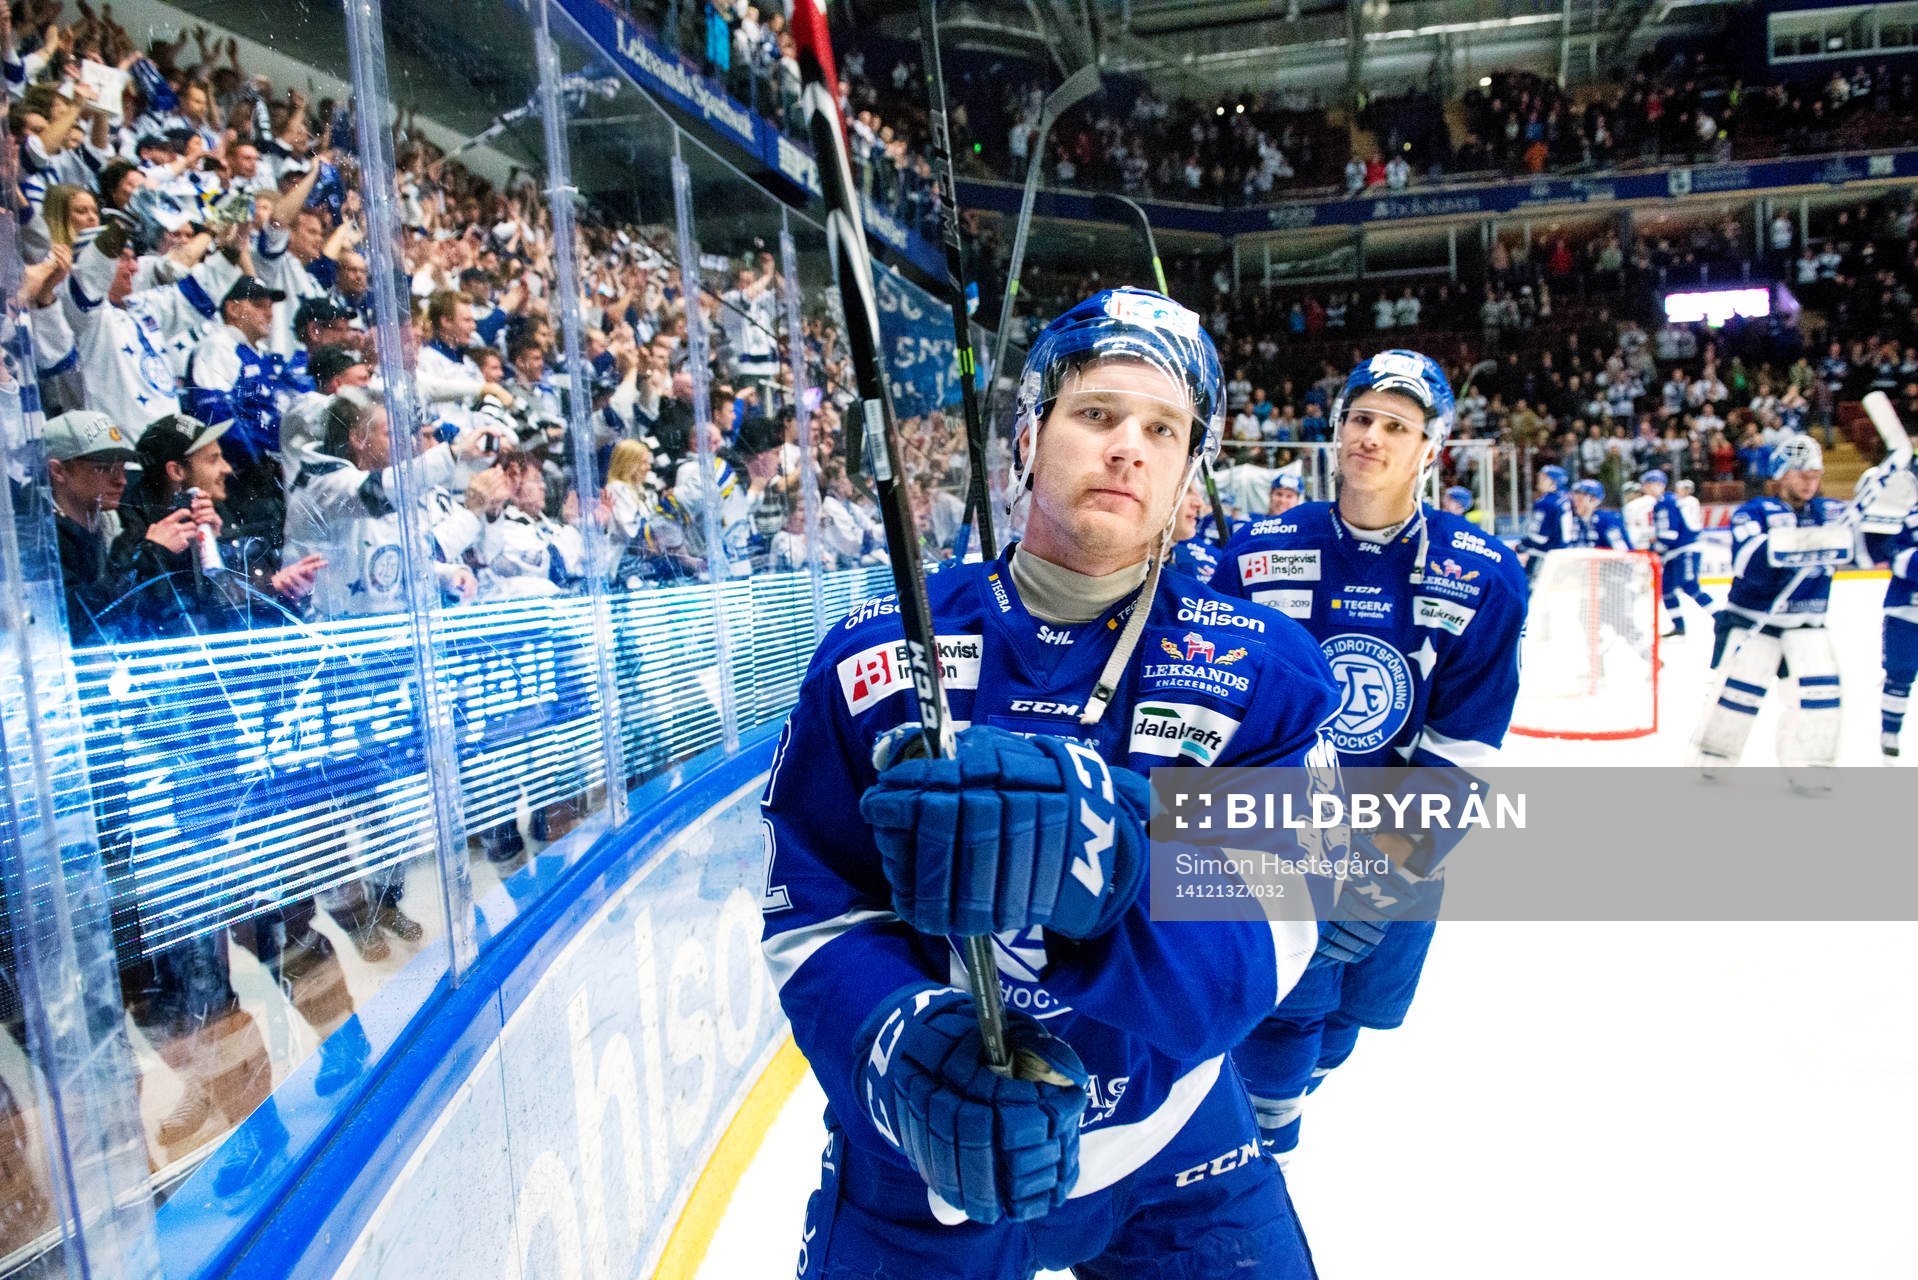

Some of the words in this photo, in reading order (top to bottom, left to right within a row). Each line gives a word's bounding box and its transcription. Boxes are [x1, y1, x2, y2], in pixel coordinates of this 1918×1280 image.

[1250, 524, 1298, 536] ohlson
[1453, 531, 1486, 547] clas
[1358, 542, 1383, 555] SHL
[1451, 540, 1502, 563] ohlson
[1271, 554, 1317, 565] Bergkvist
[1271, 566, 1304, 577] Insjön
[990, 579, 1012, 613] TEGERA
[1343, 585, 1382, 595] CCM
[1181, 596, 1234, 612] clas
[1290, 600, 1310, 608] 2019
[1343, 599, 1391, 612] TEGERA
[844, 601, 901, 630] ohls
[1036, 625, 1075, 646] SHL
[1143, 664, 1250, 692] LEKSANDS
[1335, 640, 1408, 711] IDROTTSFÖRENING
[908, 640, 939, 731] CCM
[1156, 679, 1229, 697] KNÄCKEBRÖD
[1010, 700, 1080, 716] CCM
[1134, 718, 1223, 751] dalakraft
[1175, 1137, 1260, 1188] CCM
